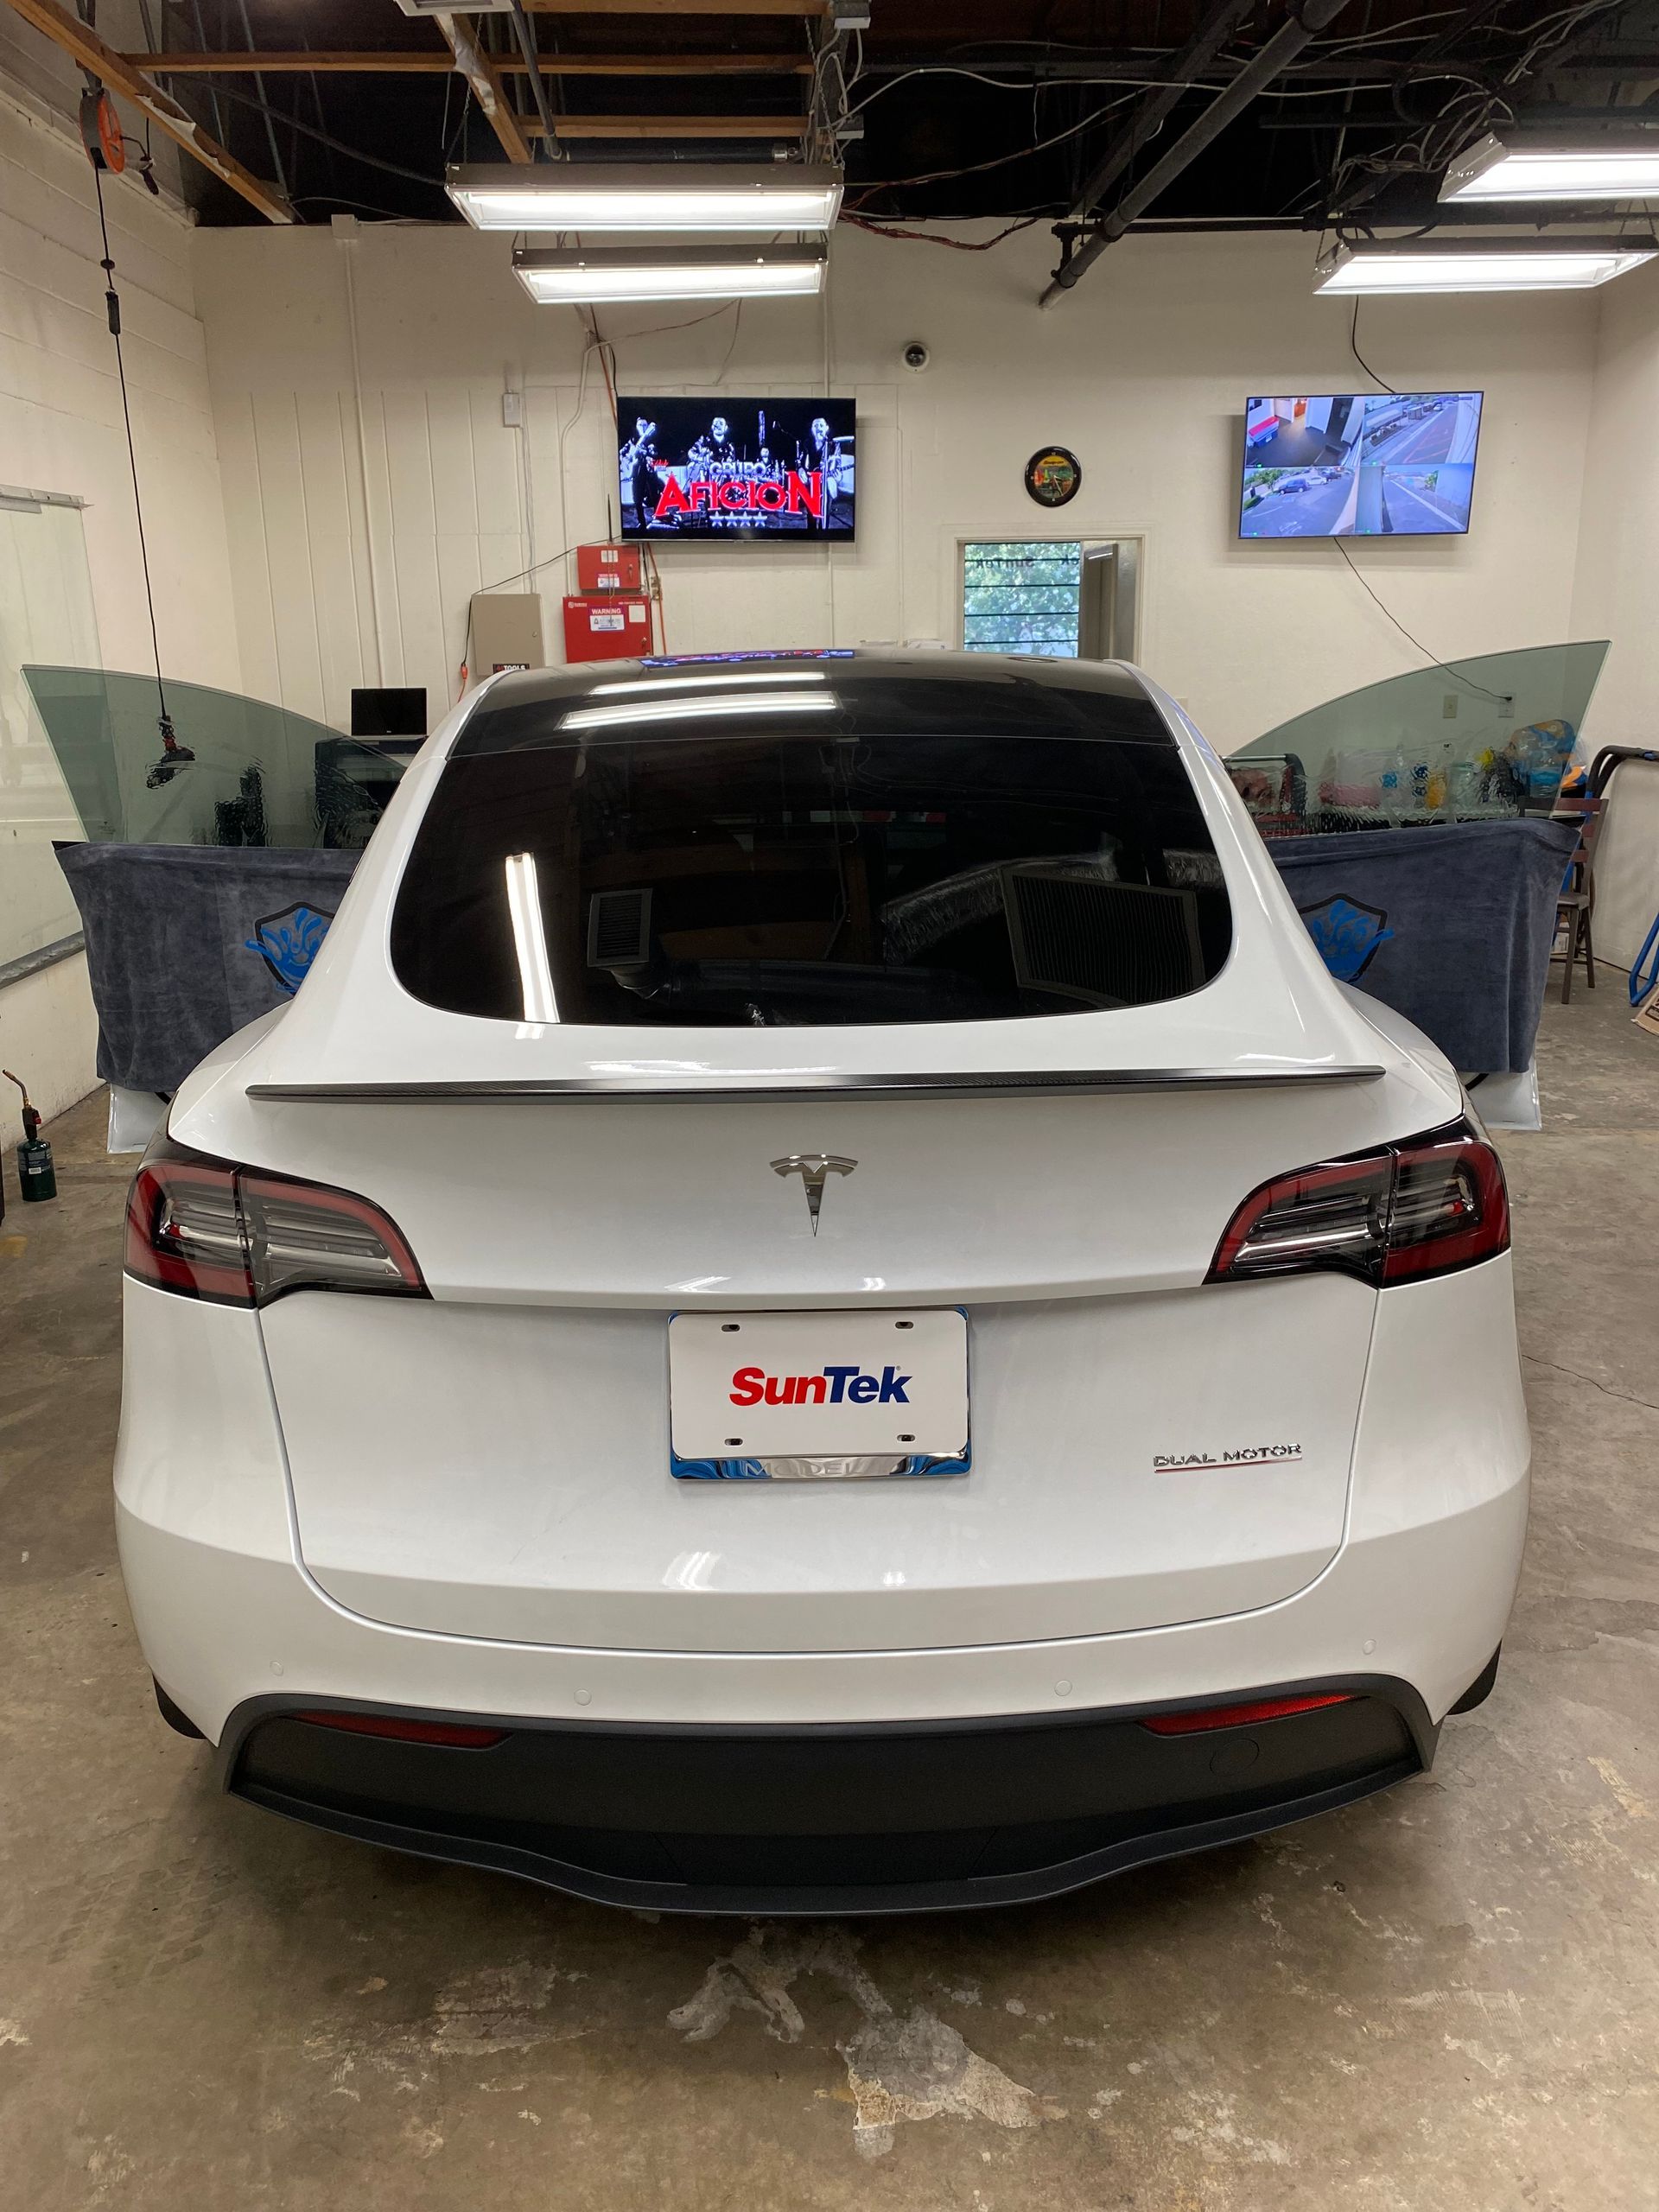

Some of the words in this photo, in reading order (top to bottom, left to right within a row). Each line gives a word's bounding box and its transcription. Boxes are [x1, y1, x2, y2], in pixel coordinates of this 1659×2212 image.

[709, 461, 766, 476] GRUPO
[654, 471, 823, 518] AFICION
[729, 1365, 913, 1407] SunTek
[1153, 1452, 1217, 1467] DUAL
[1223, 1443, 1303, 1462] MOTOR
[744, 1462, 863, 1478] MODEL
